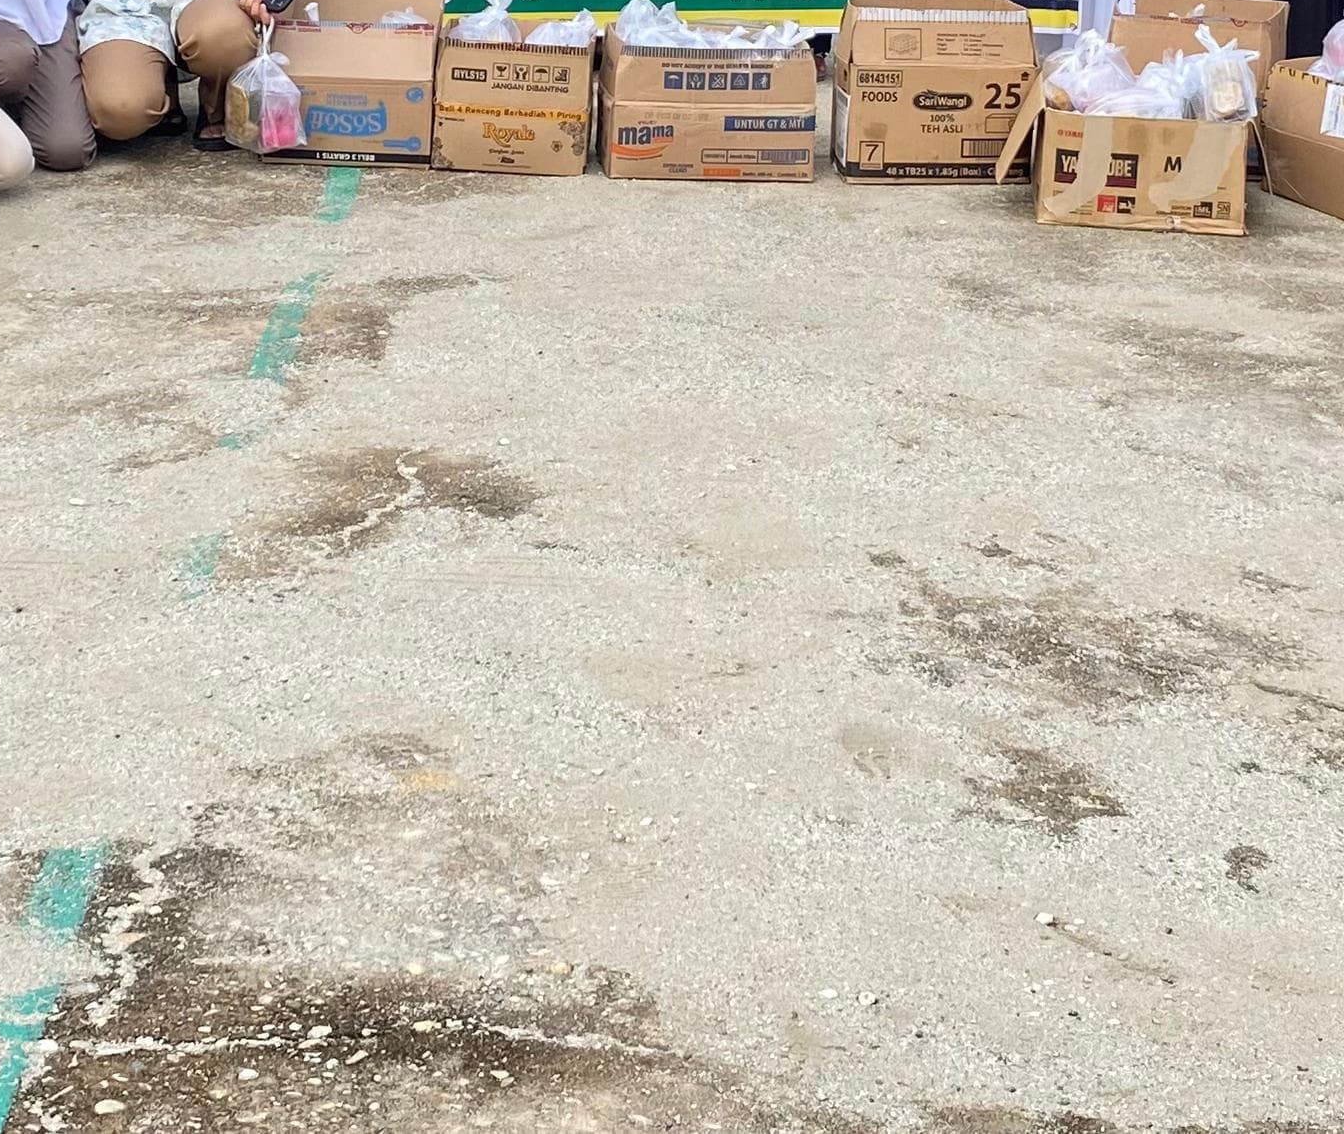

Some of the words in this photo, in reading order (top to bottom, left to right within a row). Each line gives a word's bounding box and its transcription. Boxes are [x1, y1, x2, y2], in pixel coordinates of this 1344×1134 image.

[859, 72, 900, 84] 68143151
[492, 82, 524, 91] JANGAN
[526, 85, 569, 93] DIBANTING
[862, 91, 898, 102] FOODS
[919, 94, 967, 107] SariWangi
[984, 83, 1021, 110] 25
[930, 114, 955, 122] 100%
[734, 119, 766, 130] UNTUK
[767, 120, 779, 130] GT
[780, 120, 787, 130] &
[920, 124, 940, 133] TEH
[943, 124, 963, 133] ASLI
[482, 122, 535, 147] Royale
[618, 125, 674, 145] mama
[865, 144, 879, 162] 7
